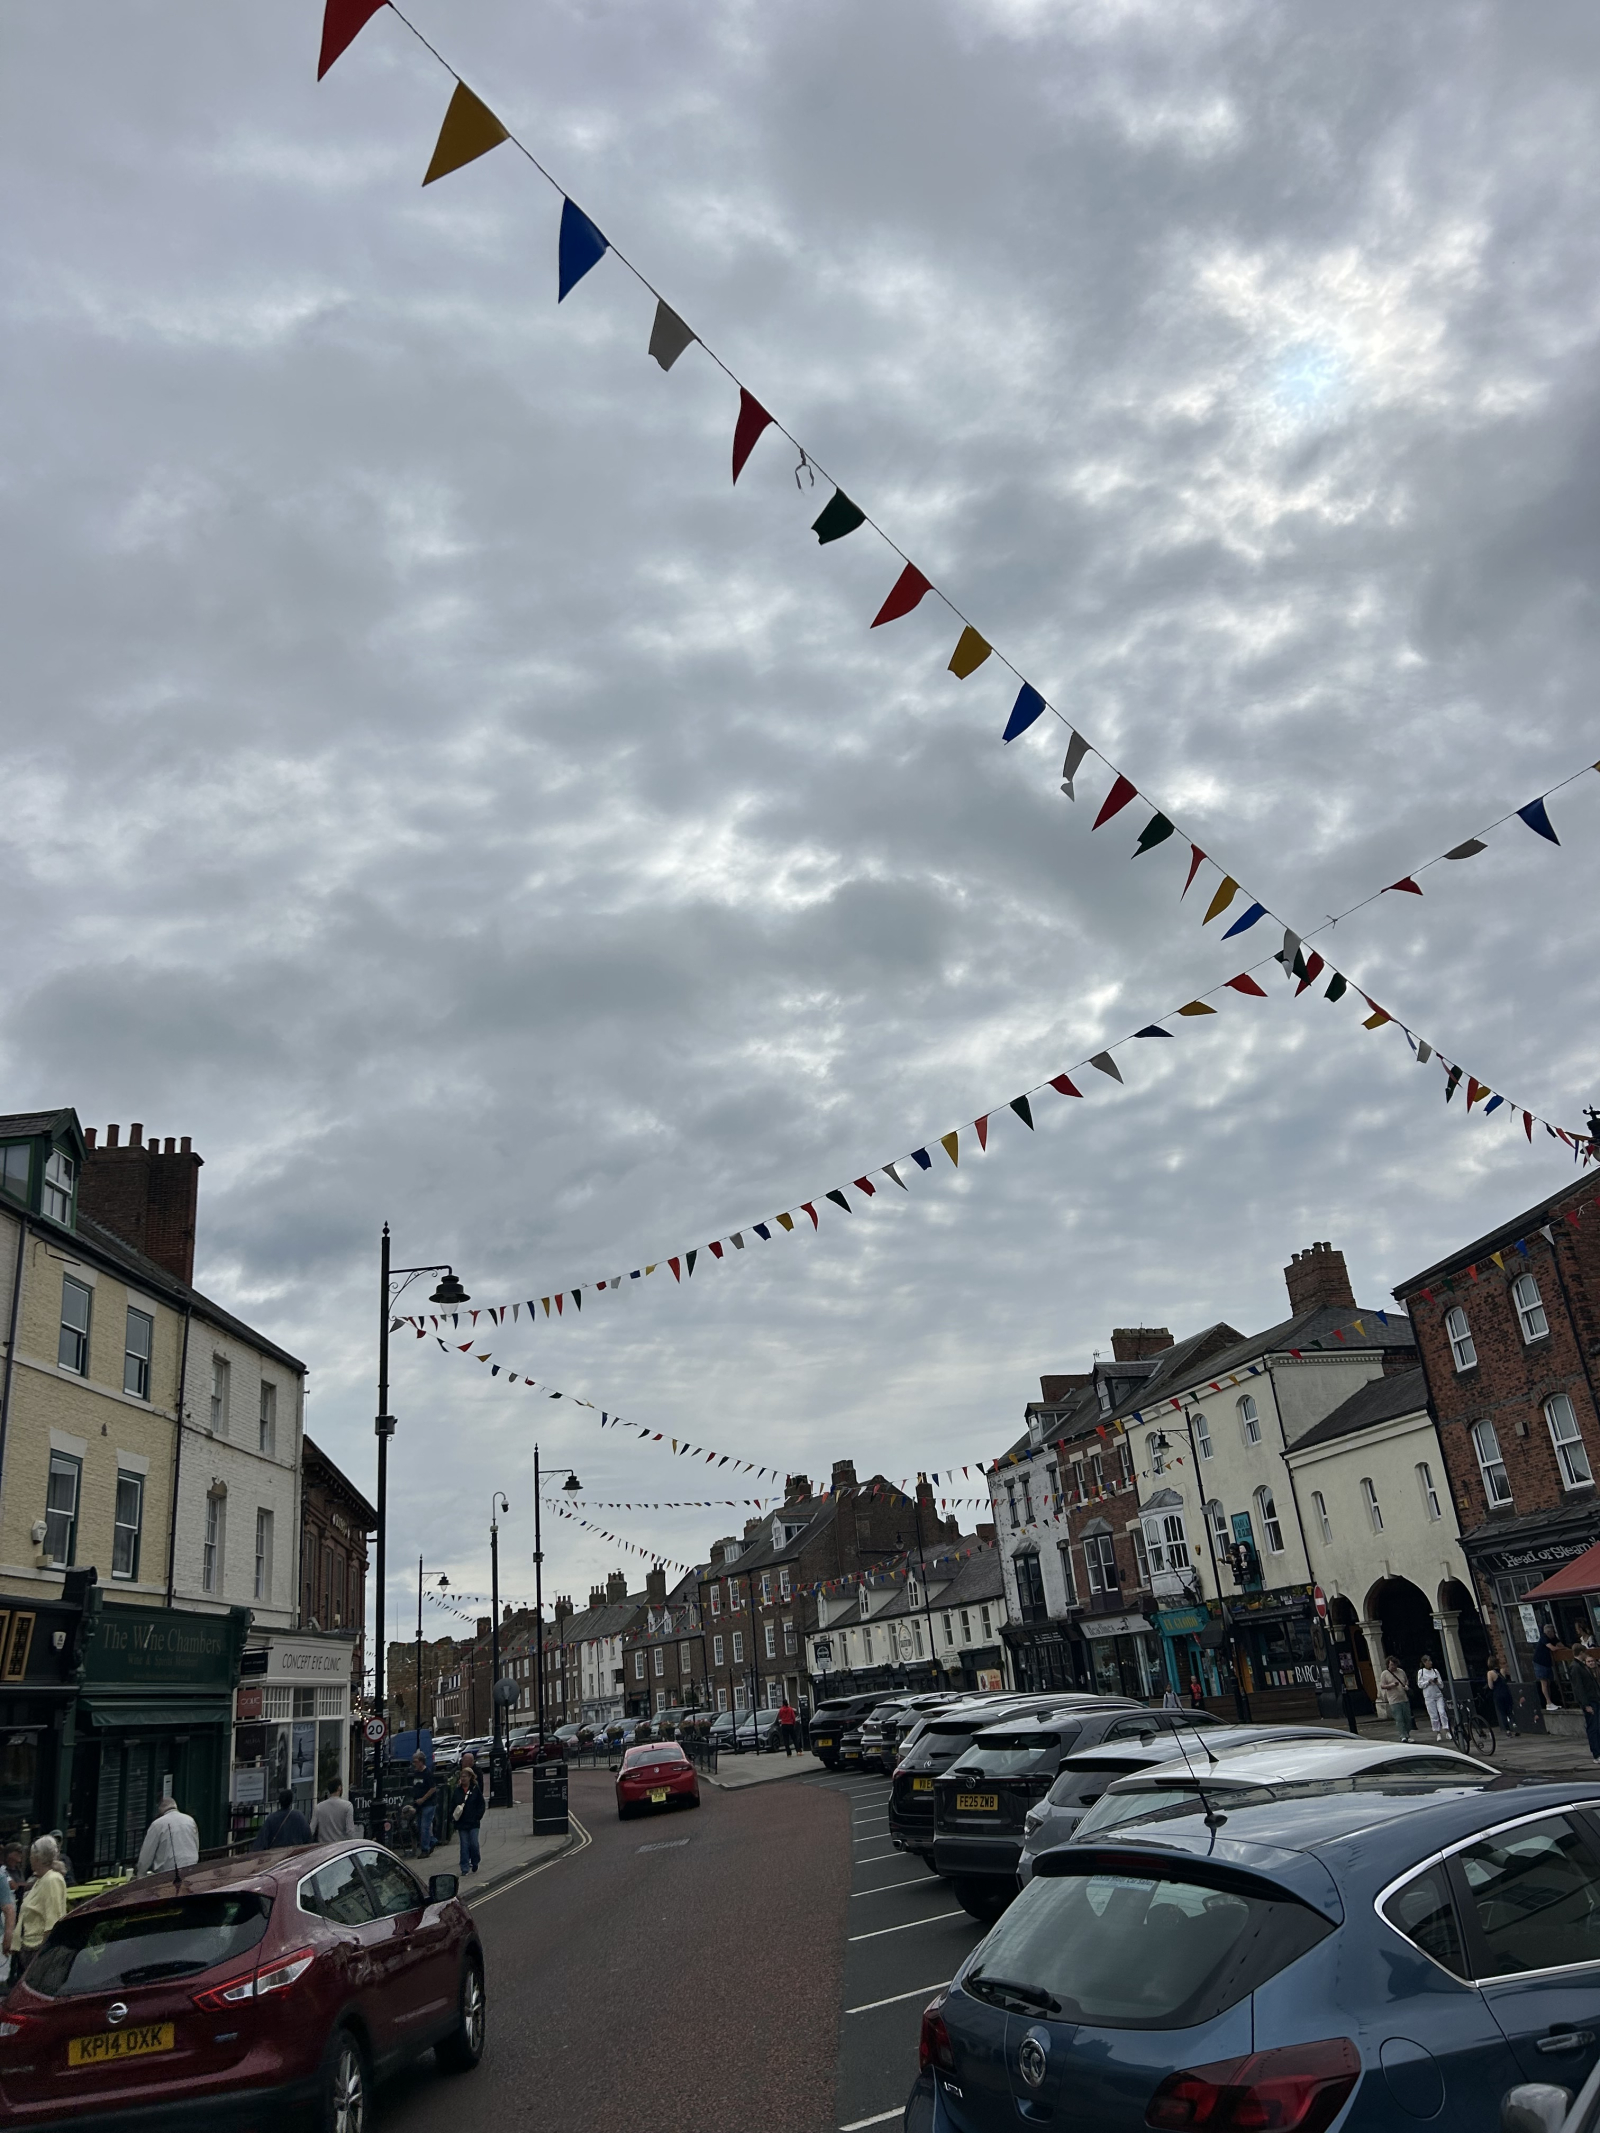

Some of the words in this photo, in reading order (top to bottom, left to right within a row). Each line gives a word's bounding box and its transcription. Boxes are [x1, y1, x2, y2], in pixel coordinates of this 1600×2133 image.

[1502, 1550, 1540, 1567] Head
[1550, 1542, 1591, 1560] Steam
[103, 1623, 128, 1650] The
[133, 1624, 165, 1650] Wine
[167, 1628, 221, 1655] Chambers
[283, 1653, 311, 1669] CONCEPT
[312, 1655, 323, 1670] EYE
[324, 1656, 341, 1671] CLINIC
[1294, 1665, 1321, 1683] BARCA
[368, 1724, 383, 1735] 20
[355, 1797, 371, 1809] The
[960, 1796, 978, 1807] FE25
[81, 2033, 121, 2060] KP14
